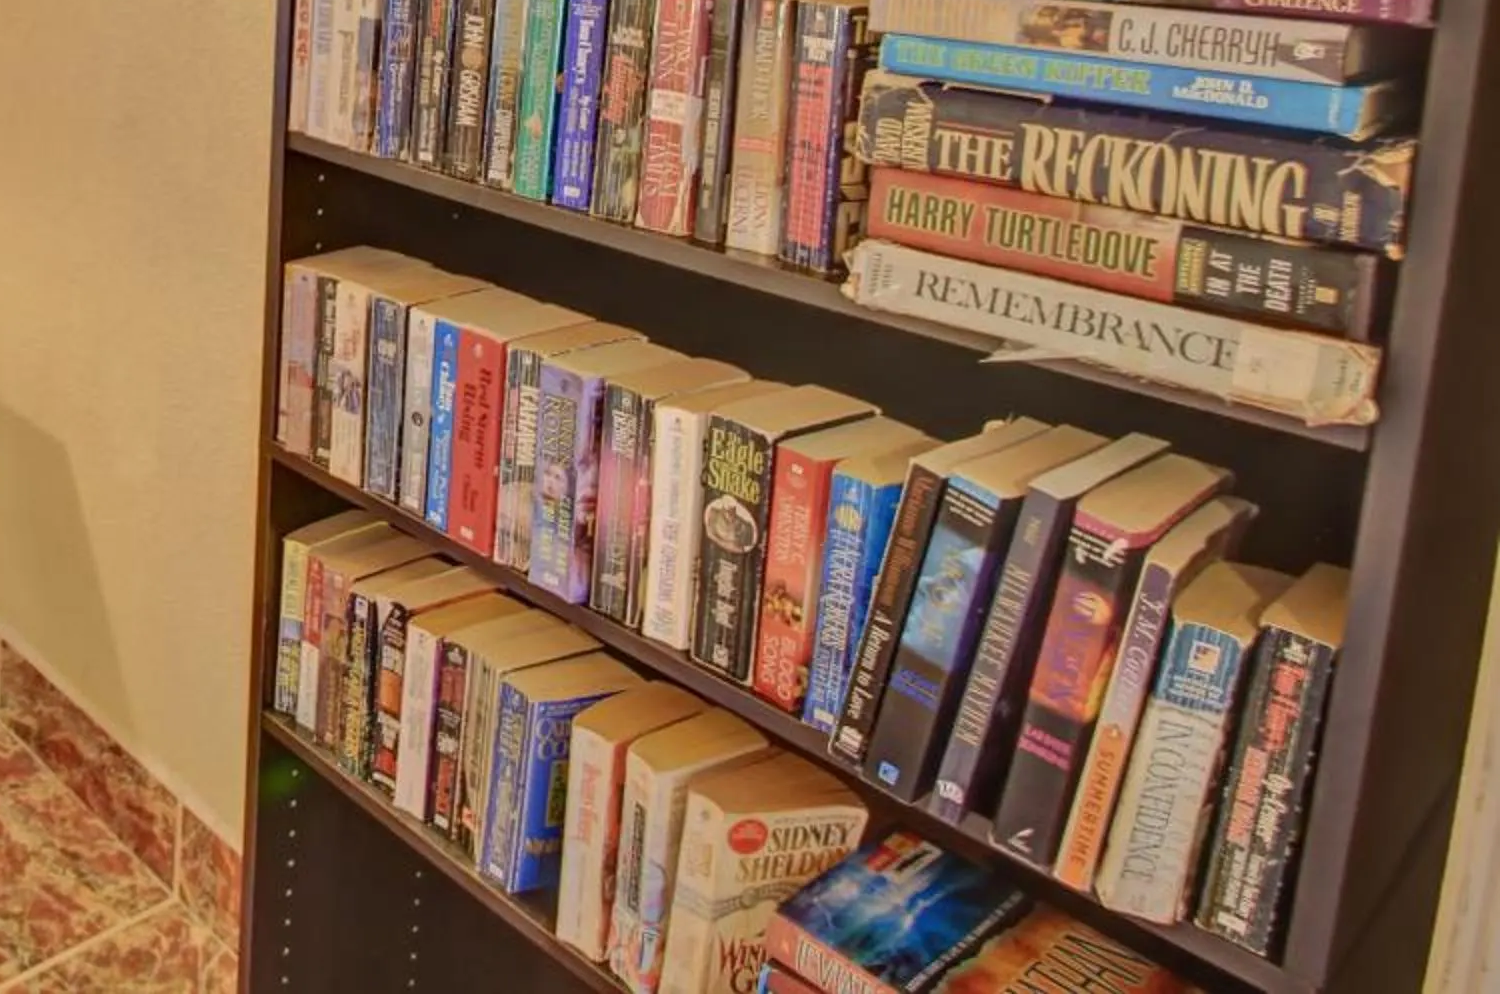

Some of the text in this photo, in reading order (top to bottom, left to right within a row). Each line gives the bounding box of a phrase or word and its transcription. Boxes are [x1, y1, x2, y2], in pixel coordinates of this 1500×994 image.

[456, 12, 485, 127] JOHN GRISHAM
[1117, 18, 1137, 53] C.
[1140, 24, 1160, 56] J.
[1166, 22, 1281, 67] CHERRYH
[933, 128, 1014, 181] THE
[1020, 123, 1308, 238] RECKONING
[886, 187, 1159, 280] HARRY TURTLEDOVE
[1206, 249, 1234, 298] IN AT
[1235, 262, 1262, 295] THE
[916, 269, 1242, 371] REMEMBRANCE
[1263, 258, 1293, 313] DEATH
[458, 382, 477, 443] Rising
[474, 368, 492, 469] Red Storm
[760, 633, 779, 686] SONG
[775, 636, 797, 700] BLOOD
[845, 610, 892, 719] A Return to Love
[952, 563, 1031, 746] MILWAUKEE MAYHEM
[768, 821, 857, 854] SIDNEY
[1069, 749, 1116, 866] SUMMERTIME
[1120, 719, 1195, 883] IN CONFIDENCE
